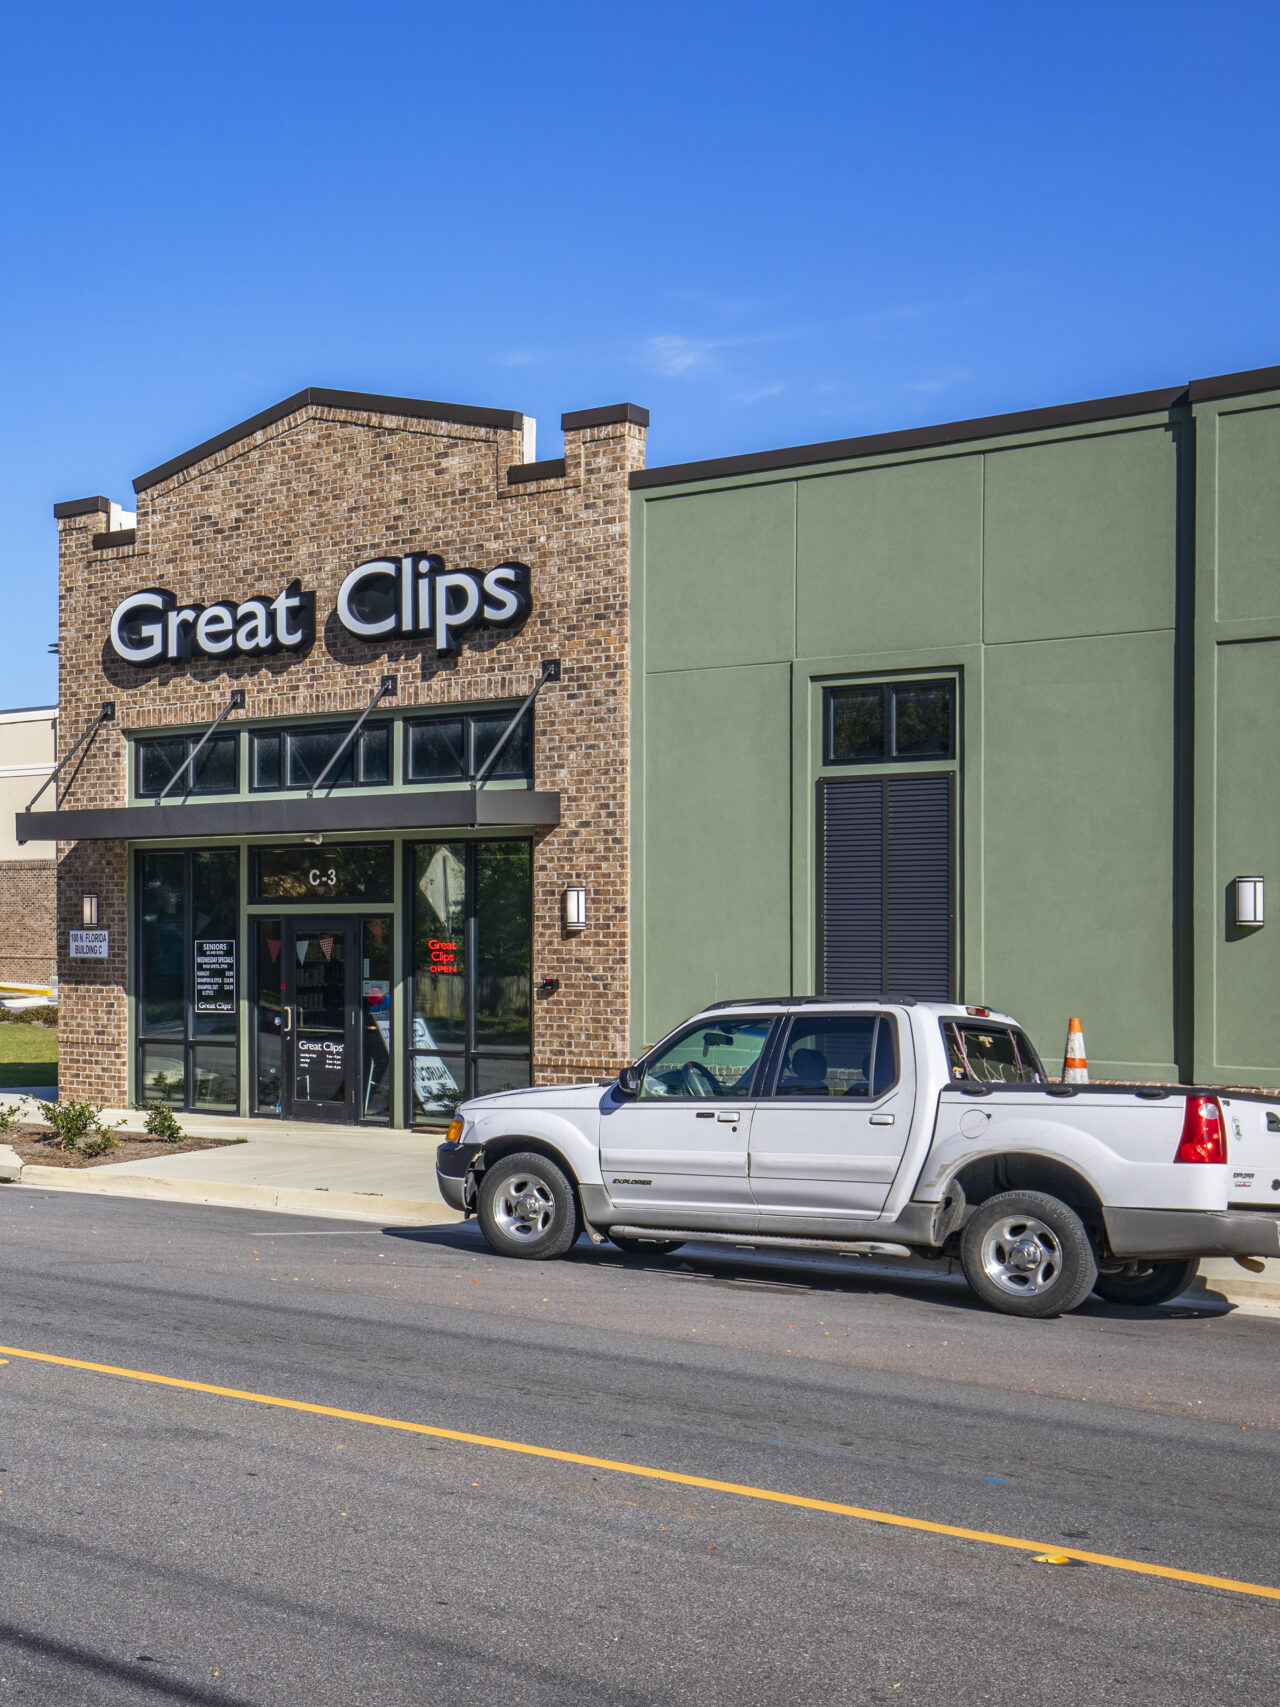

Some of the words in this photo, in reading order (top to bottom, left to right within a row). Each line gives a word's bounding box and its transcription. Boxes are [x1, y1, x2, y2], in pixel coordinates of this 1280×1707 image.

[110, 589, 302, 661] Great
[337, 557, 519, 650] Clips
[309, 869, 336, 885] C-3
[71, 933, 79, 943] 100
[86, 933, 107, 943] FLORIDA
[75, 945, 97, 954] BUILDING
[203, 943, 227, 951] SENIORS
[428, 939, 457, 950] Great
[431, 951, 455, 964] Clips
[430, 965, 458, 973] OPEN
[216, 1002, 231, 1011] Clips
[299, 1040, 322, 1051] Great
[323, 1042, 343, 1054] Clips
[612, 1178, 653, 1186] EXPLORER
